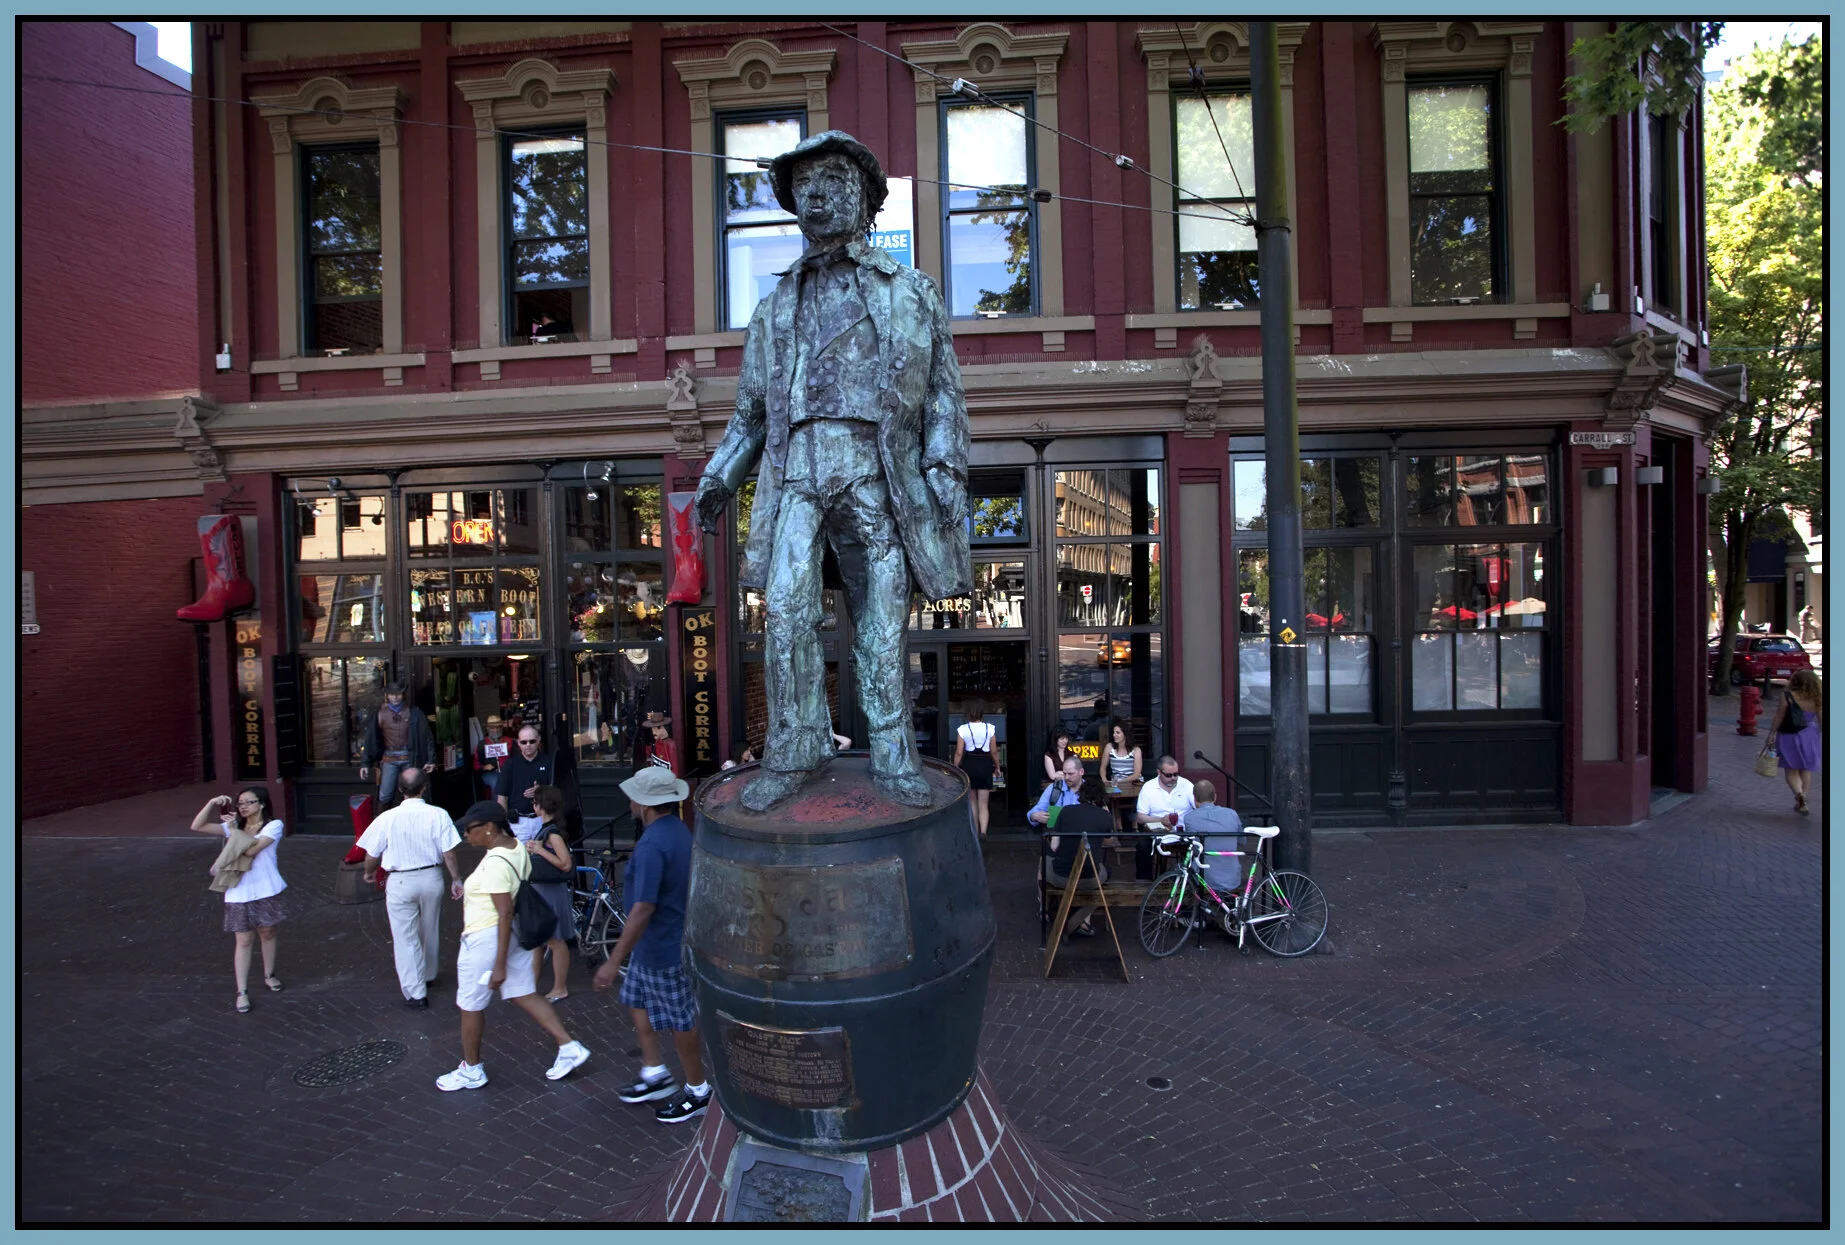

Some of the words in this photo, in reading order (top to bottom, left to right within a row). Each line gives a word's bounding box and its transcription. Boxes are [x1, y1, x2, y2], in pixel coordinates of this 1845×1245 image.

[869, 233, 908, 249] LEASE
[1573, 433, 1611, 443] CARRALL
[451, 520, 494, 544] OPEN
[463, 572, 494, 585] B.C.'S
[500, 589, 536, 605] BOOT
[923, 599, 972, 612] ACRES
[684, 612, 714, 631] OK
[236, 624, 262, 644] OK
[692, 635, 708, 683] BOOT
[243, 647, 257, 692] BOOT
[244, 700, 260, 766] CORRAL
[694, 691, 710, 761] CORRAL
[1067, 745, 1099, 758] PEN
